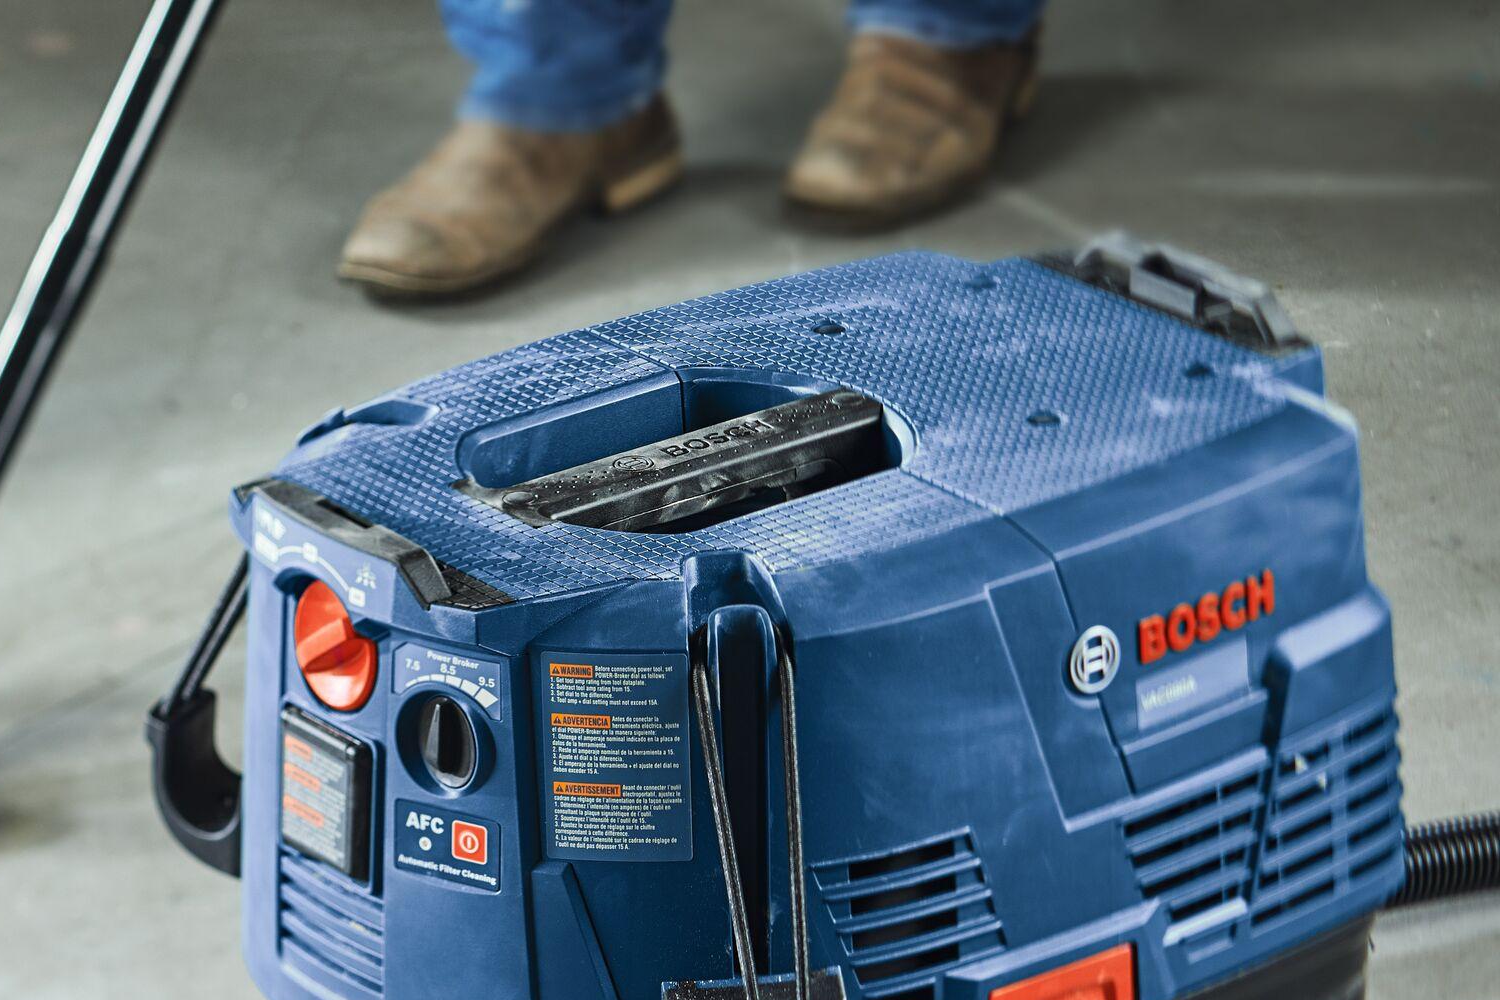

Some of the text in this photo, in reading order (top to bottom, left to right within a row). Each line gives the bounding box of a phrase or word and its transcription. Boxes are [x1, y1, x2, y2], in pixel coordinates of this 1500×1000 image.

[660, 419, 773, 458] BOSCH
[1139, 568, 1275, 664] BOSCH
[426, 650, 480, 670] Power Broker
[560, 666, 592, 676] WARNING
[405, 658, 495, 688] 7.5 8.5 9.5
[562, 716, 609, 726] ADVERTENCIA
[565, 784, 619, 795] AVERTISSEMENT
[406, 811, 444, 834] AFC
[398, 854, 497, 885] Automatic Filter Cleaning
